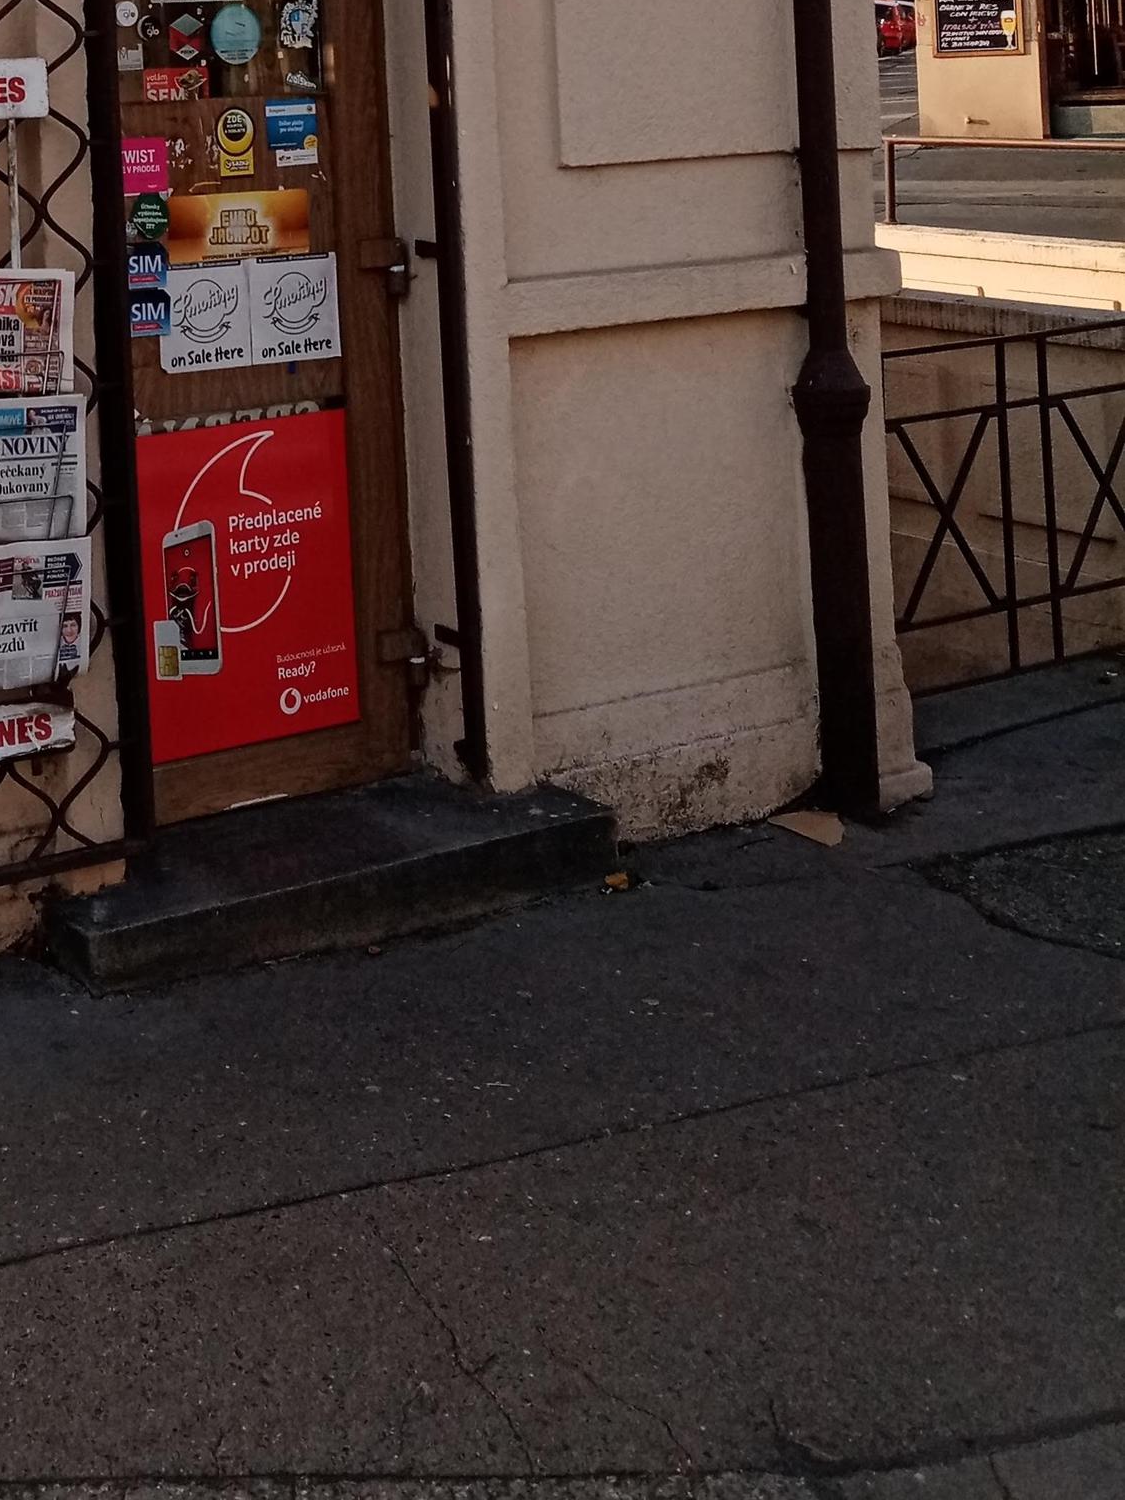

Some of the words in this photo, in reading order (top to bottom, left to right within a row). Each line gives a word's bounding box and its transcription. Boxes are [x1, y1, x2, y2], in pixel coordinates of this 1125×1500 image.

[221, 209, 257, 228] EURO
[129, 255, 162, 274] SIM
[131, 303, 165, 321] SIM
[188, 350, 212, 366] Sale
[215, 346, 244, 360] Here
[277, 341, 302, 356] Sale
[304, 337, 332, 350] Here
[2, 435, 71, 458] NOVINY
[228, 501, 322, 533] Předplacené
[229, 533, 270, 555] karty
[273, 529, 300, 548] zde
[230, 563, 241, 577] v
[244, 551, 297, 579] prodeji
[278, 660, 316, 680] Ready?
[303, 686, 350, 704] vodafone
